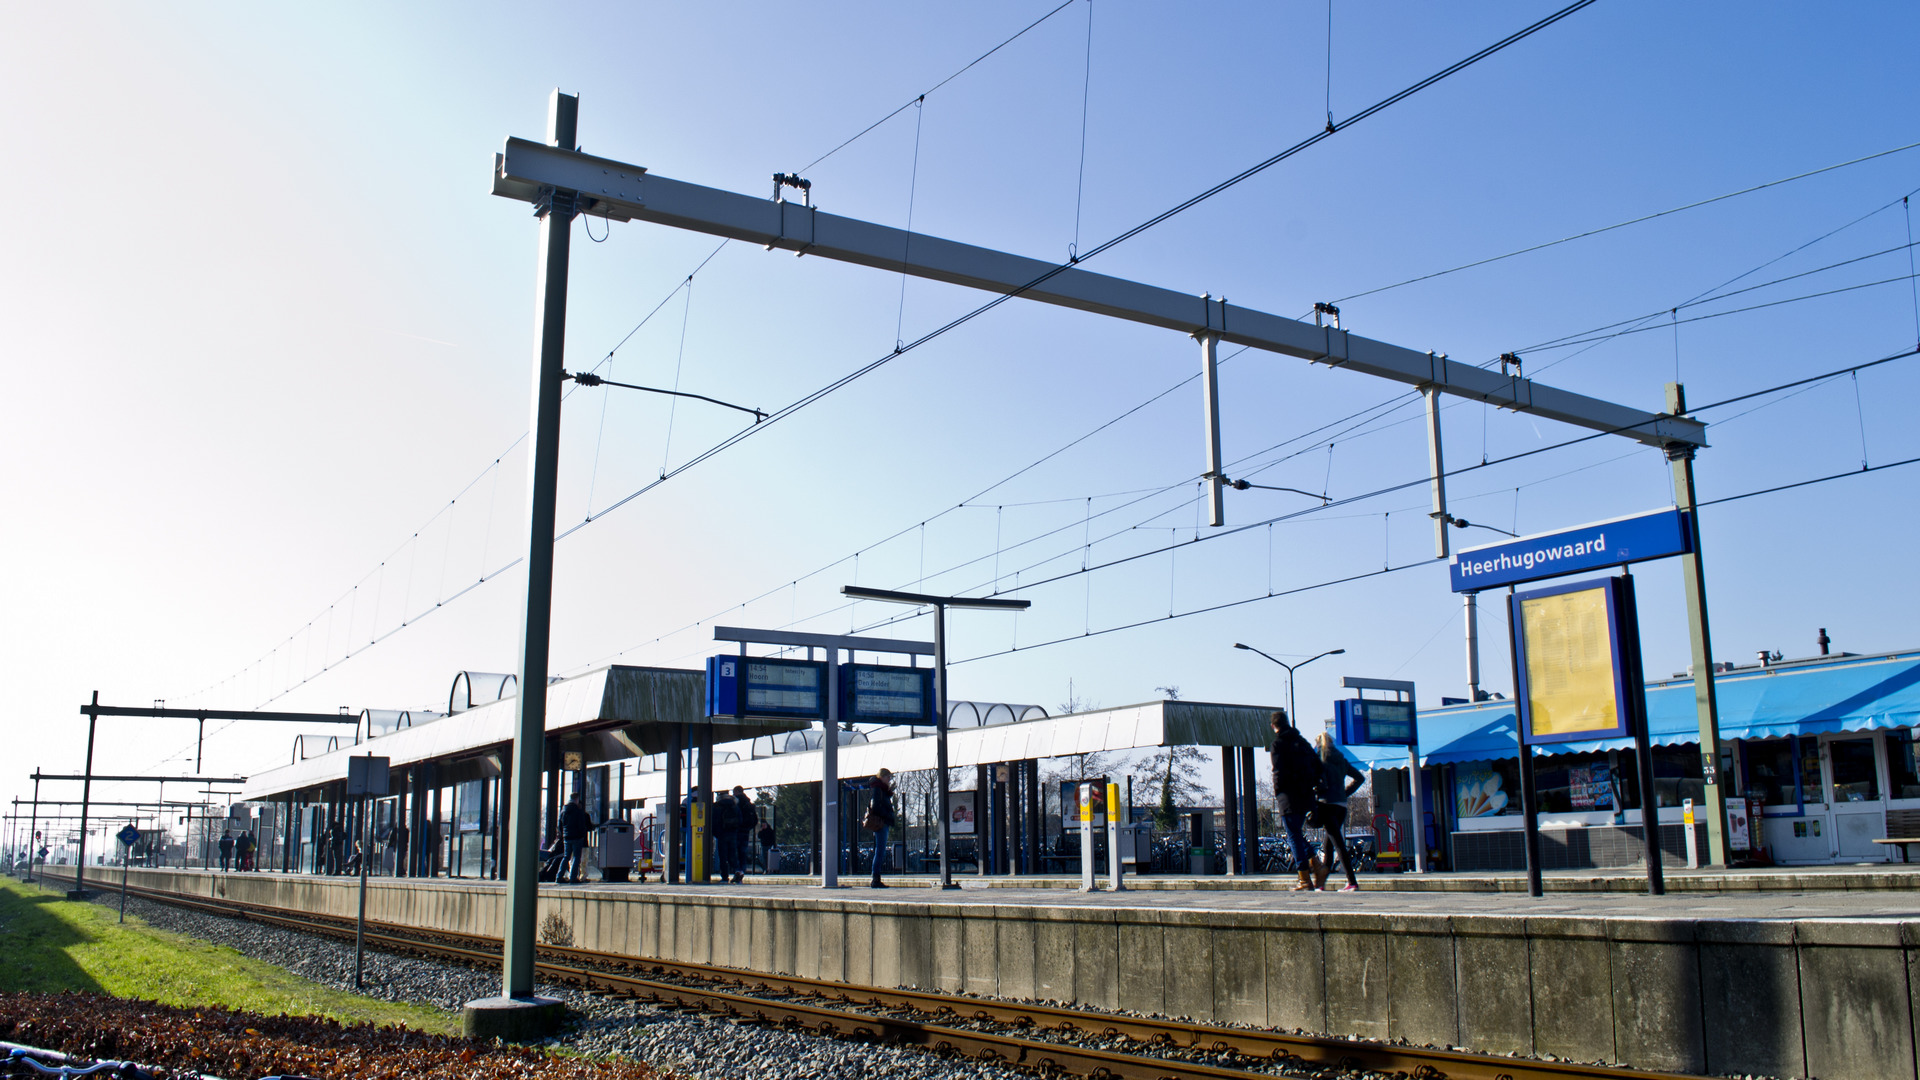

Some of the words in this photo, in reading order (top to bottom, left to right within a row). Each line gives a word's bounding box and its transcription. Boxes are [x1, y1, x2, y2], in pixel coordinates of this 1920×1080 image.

[1461, 534, 1606, 577] Heerhugowaard
[725, 667, 730, 675] 3
[1707, 776, 1713, 784] 6
[125, 831, 134, 840] 2
